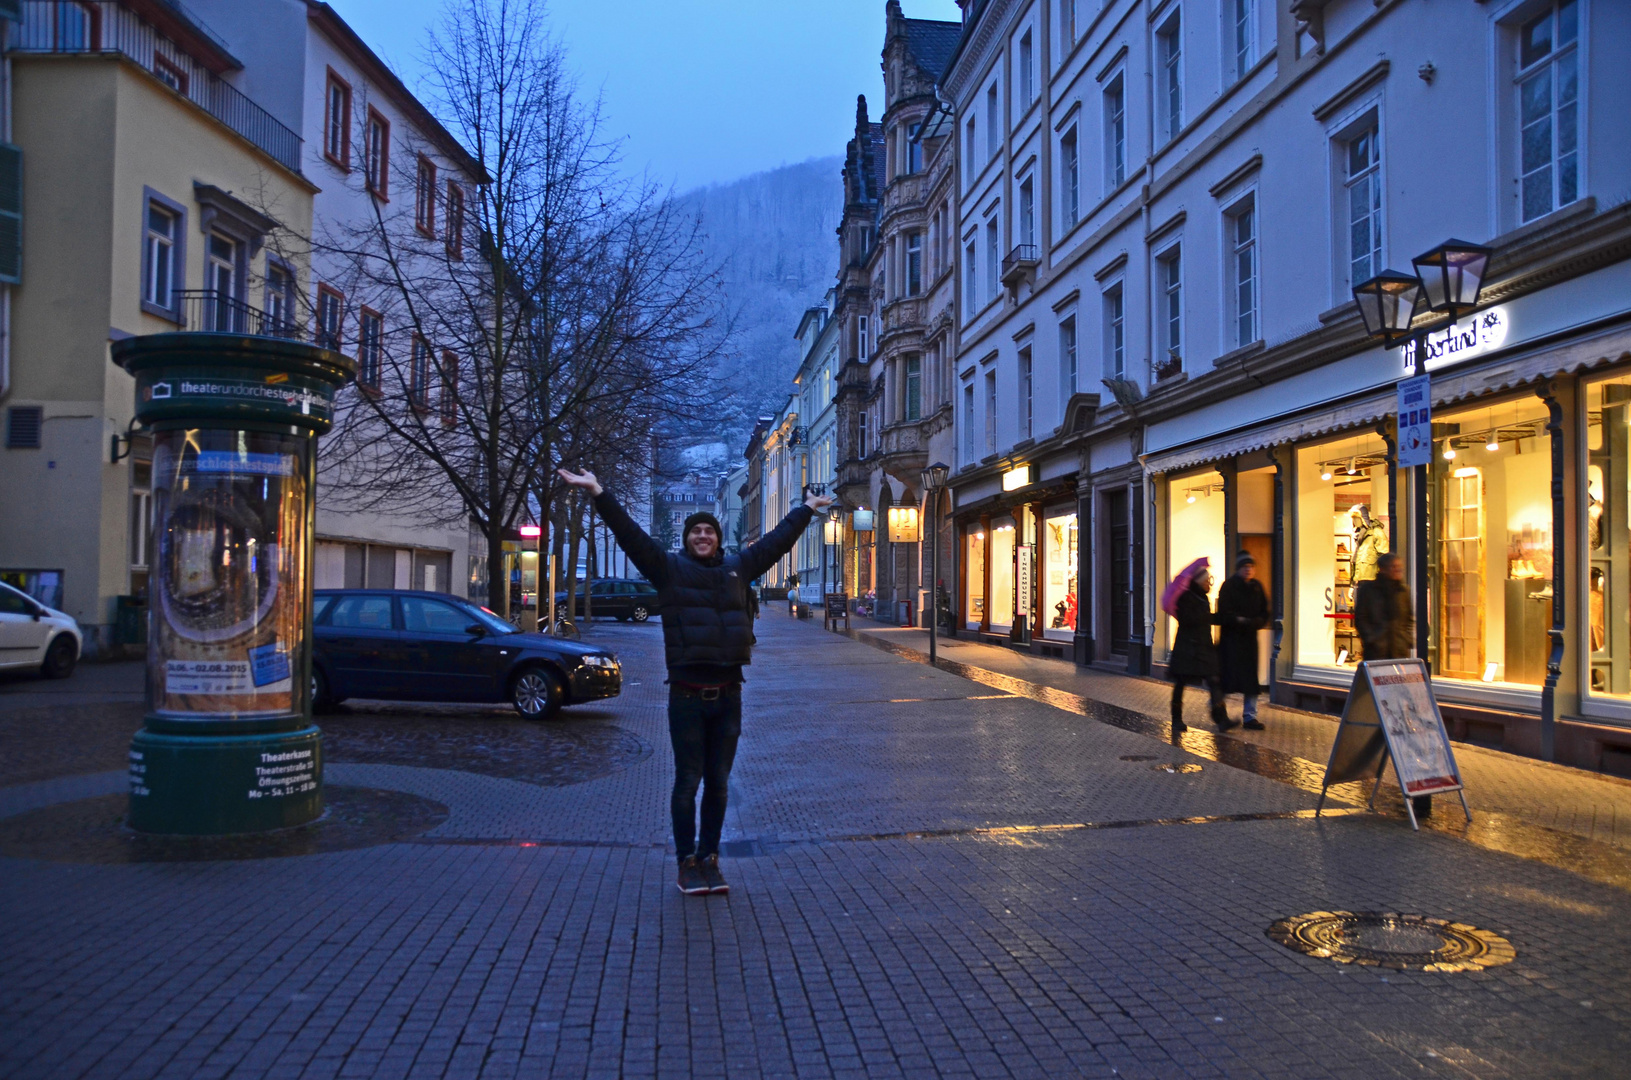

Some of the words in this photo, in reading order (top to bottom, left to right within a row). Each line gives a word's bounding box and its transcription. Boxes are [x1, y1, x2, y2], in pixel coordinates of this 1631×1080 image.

[1401, 319, 1476, 367] Tiberland
[261, 749, 312, 763] Theaterkasse
[256, 762, 306, 776] Theaterstraße
[248, 789, 263, 799] Mo
[271, 787, 284, 798] Sa,
[286, 786, 294, 795] 11
